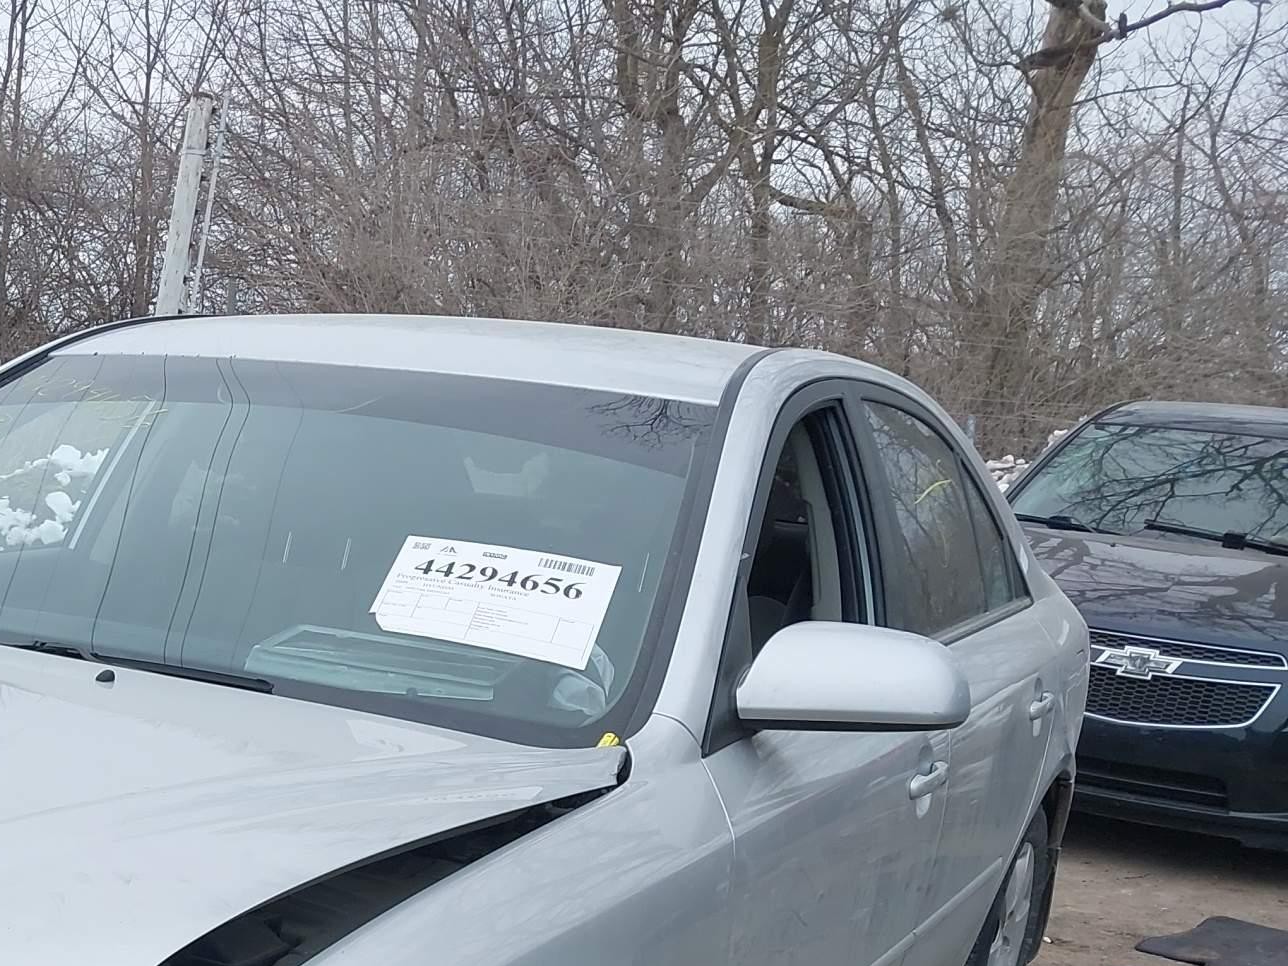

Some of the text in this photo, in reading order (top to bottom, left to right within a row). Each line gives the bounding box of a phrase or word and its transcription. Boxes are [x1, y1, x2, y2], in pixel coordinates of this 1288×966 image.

[414, 559, 586, 600] 44294656
[448, 578, 484, 590] Casualty
[488, 584, 530, 597] Insurance
